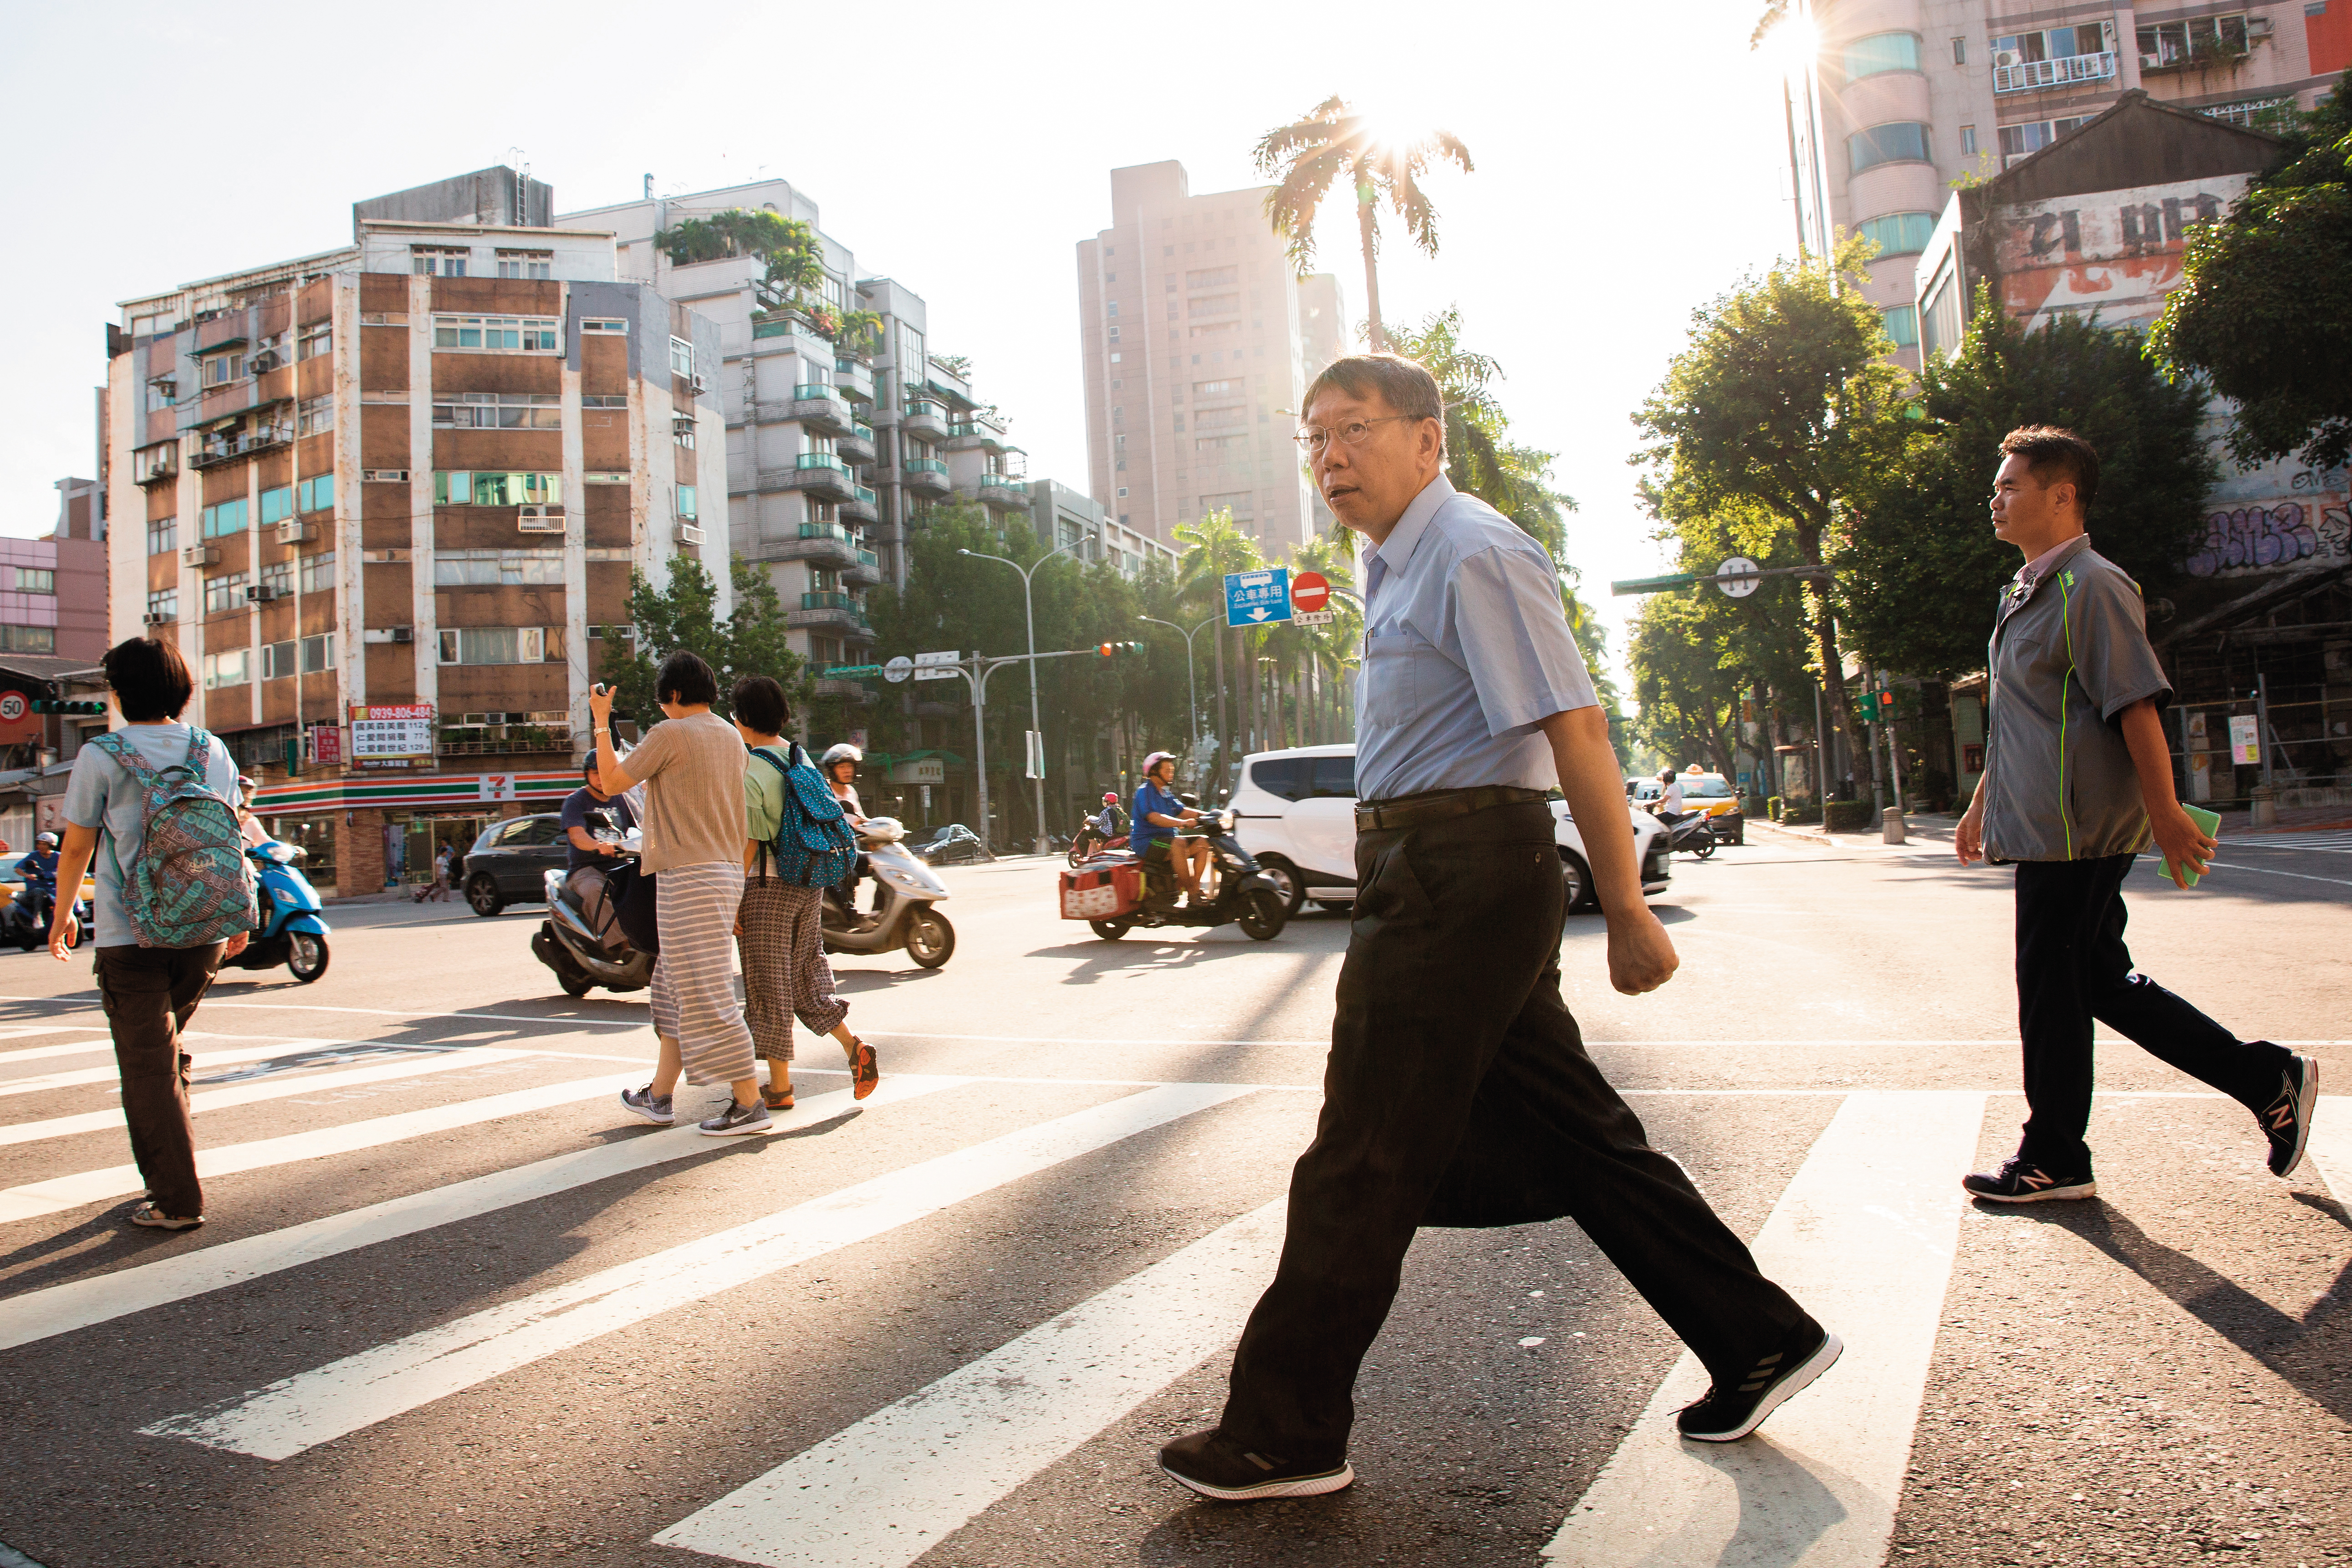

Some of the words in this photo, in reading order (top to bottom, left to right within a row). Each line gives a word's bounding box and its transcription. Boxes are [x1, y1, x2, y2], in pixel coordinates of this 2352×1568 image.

[1234, 585, 1282, 602] 公車專用
[2, 700, 21, 714] 50
[370, 707, 430, 719] 0939-806-484
[2268, 1104, 2293, 1129] N
[2020, 1169, 2054, 1190] N
